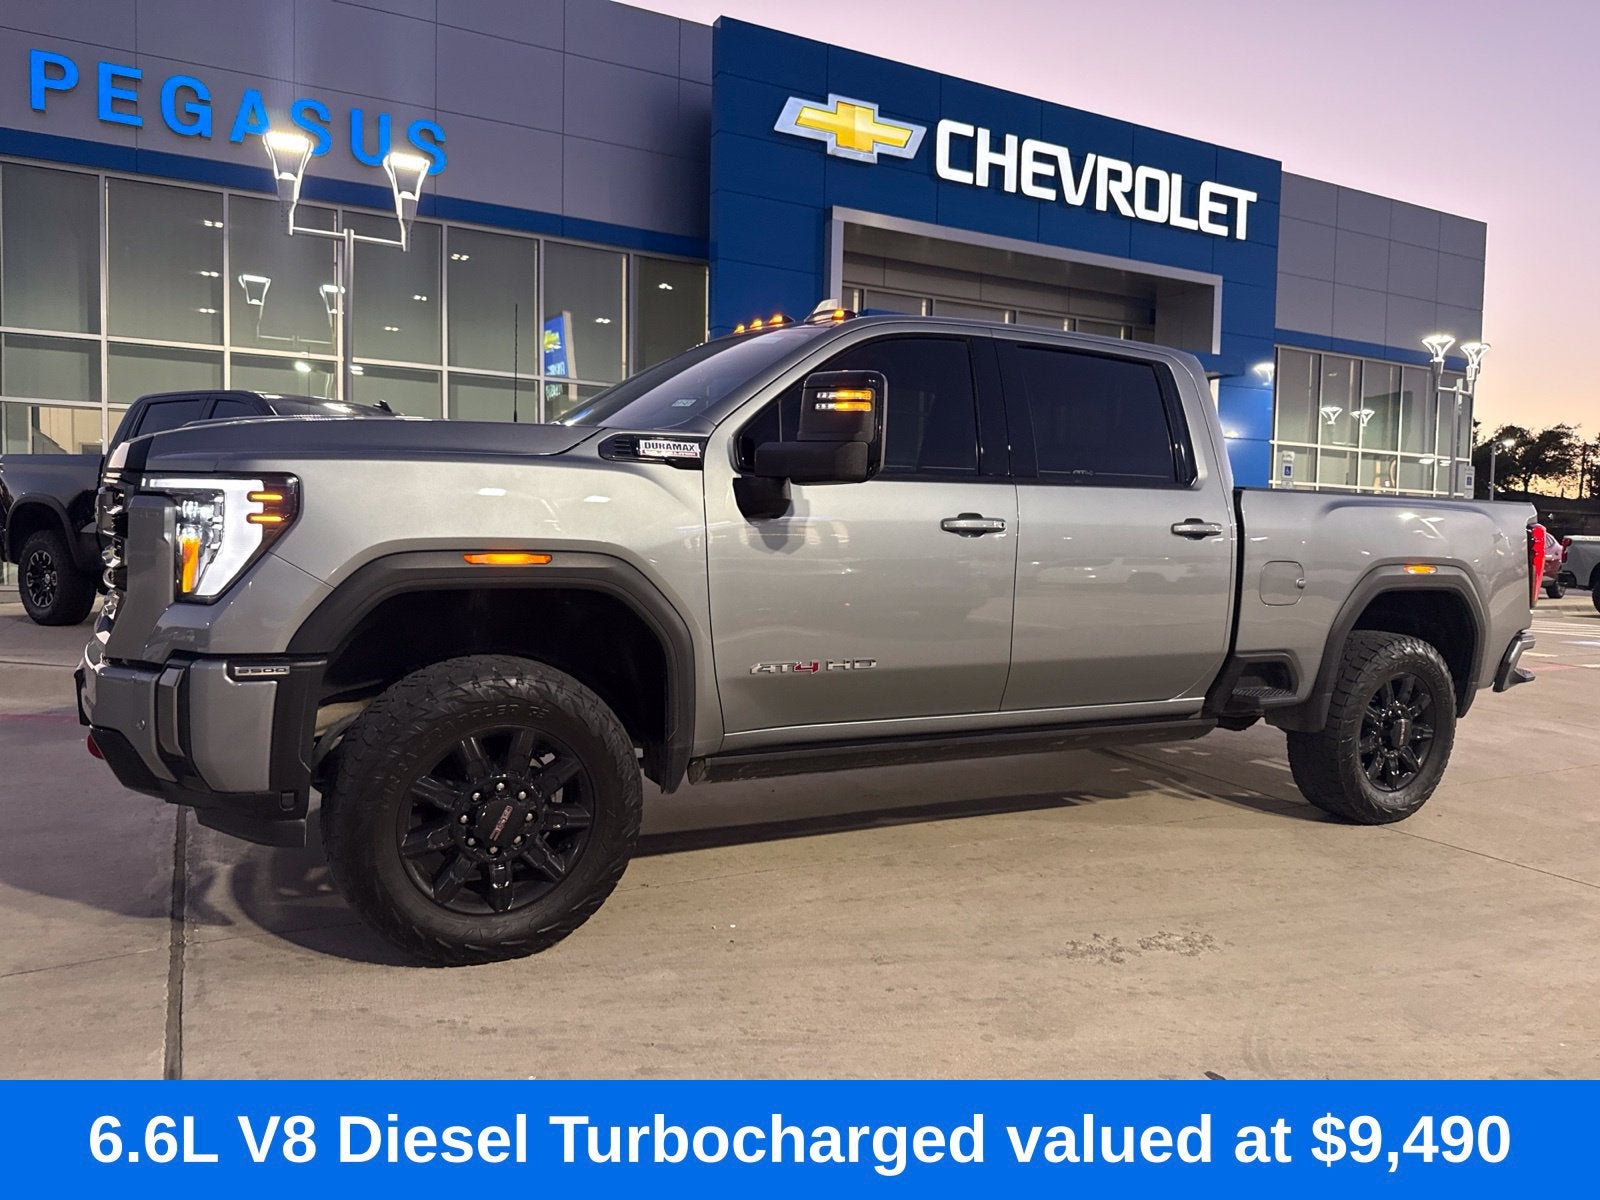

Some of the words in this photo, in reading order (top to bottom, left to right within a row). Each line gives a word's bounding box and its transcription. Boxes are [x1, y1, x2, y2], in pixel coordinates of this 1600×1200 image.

[29, 49, 448, 176] PEGASUS
[936, 119, 1258, 240] CHEVROLET
[643, 441, 695, 451] DURAMAX
[749, 661, 820, 675] AT4
[826, 659, 877, 671] HD
